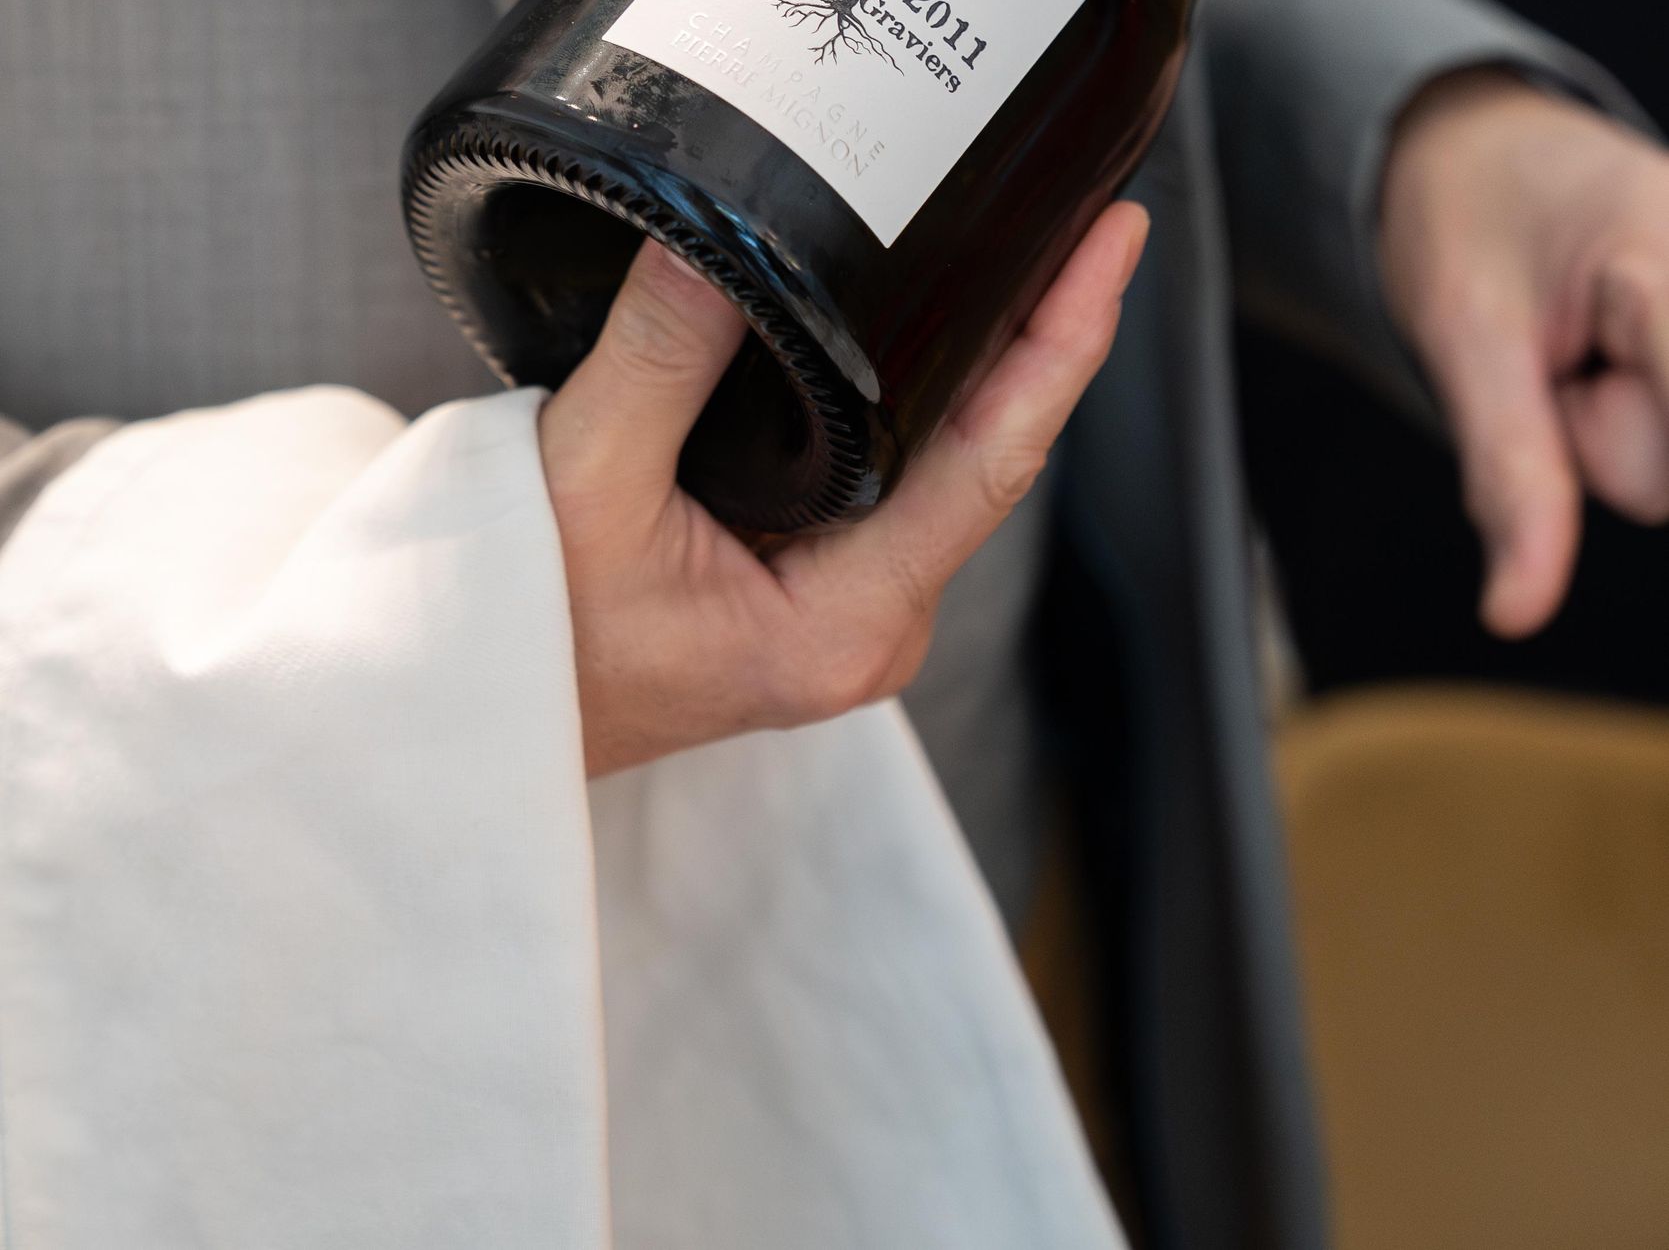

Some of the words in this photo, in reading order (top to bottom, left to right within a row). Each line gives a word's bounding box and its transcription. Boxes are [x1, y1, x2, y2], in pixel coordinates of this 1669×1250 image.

[669, 29, 760, 89] PIERRE
[760, 84, 869, 179] MIGNON
[688, 11, 885, 161] CHAMPAGNE
